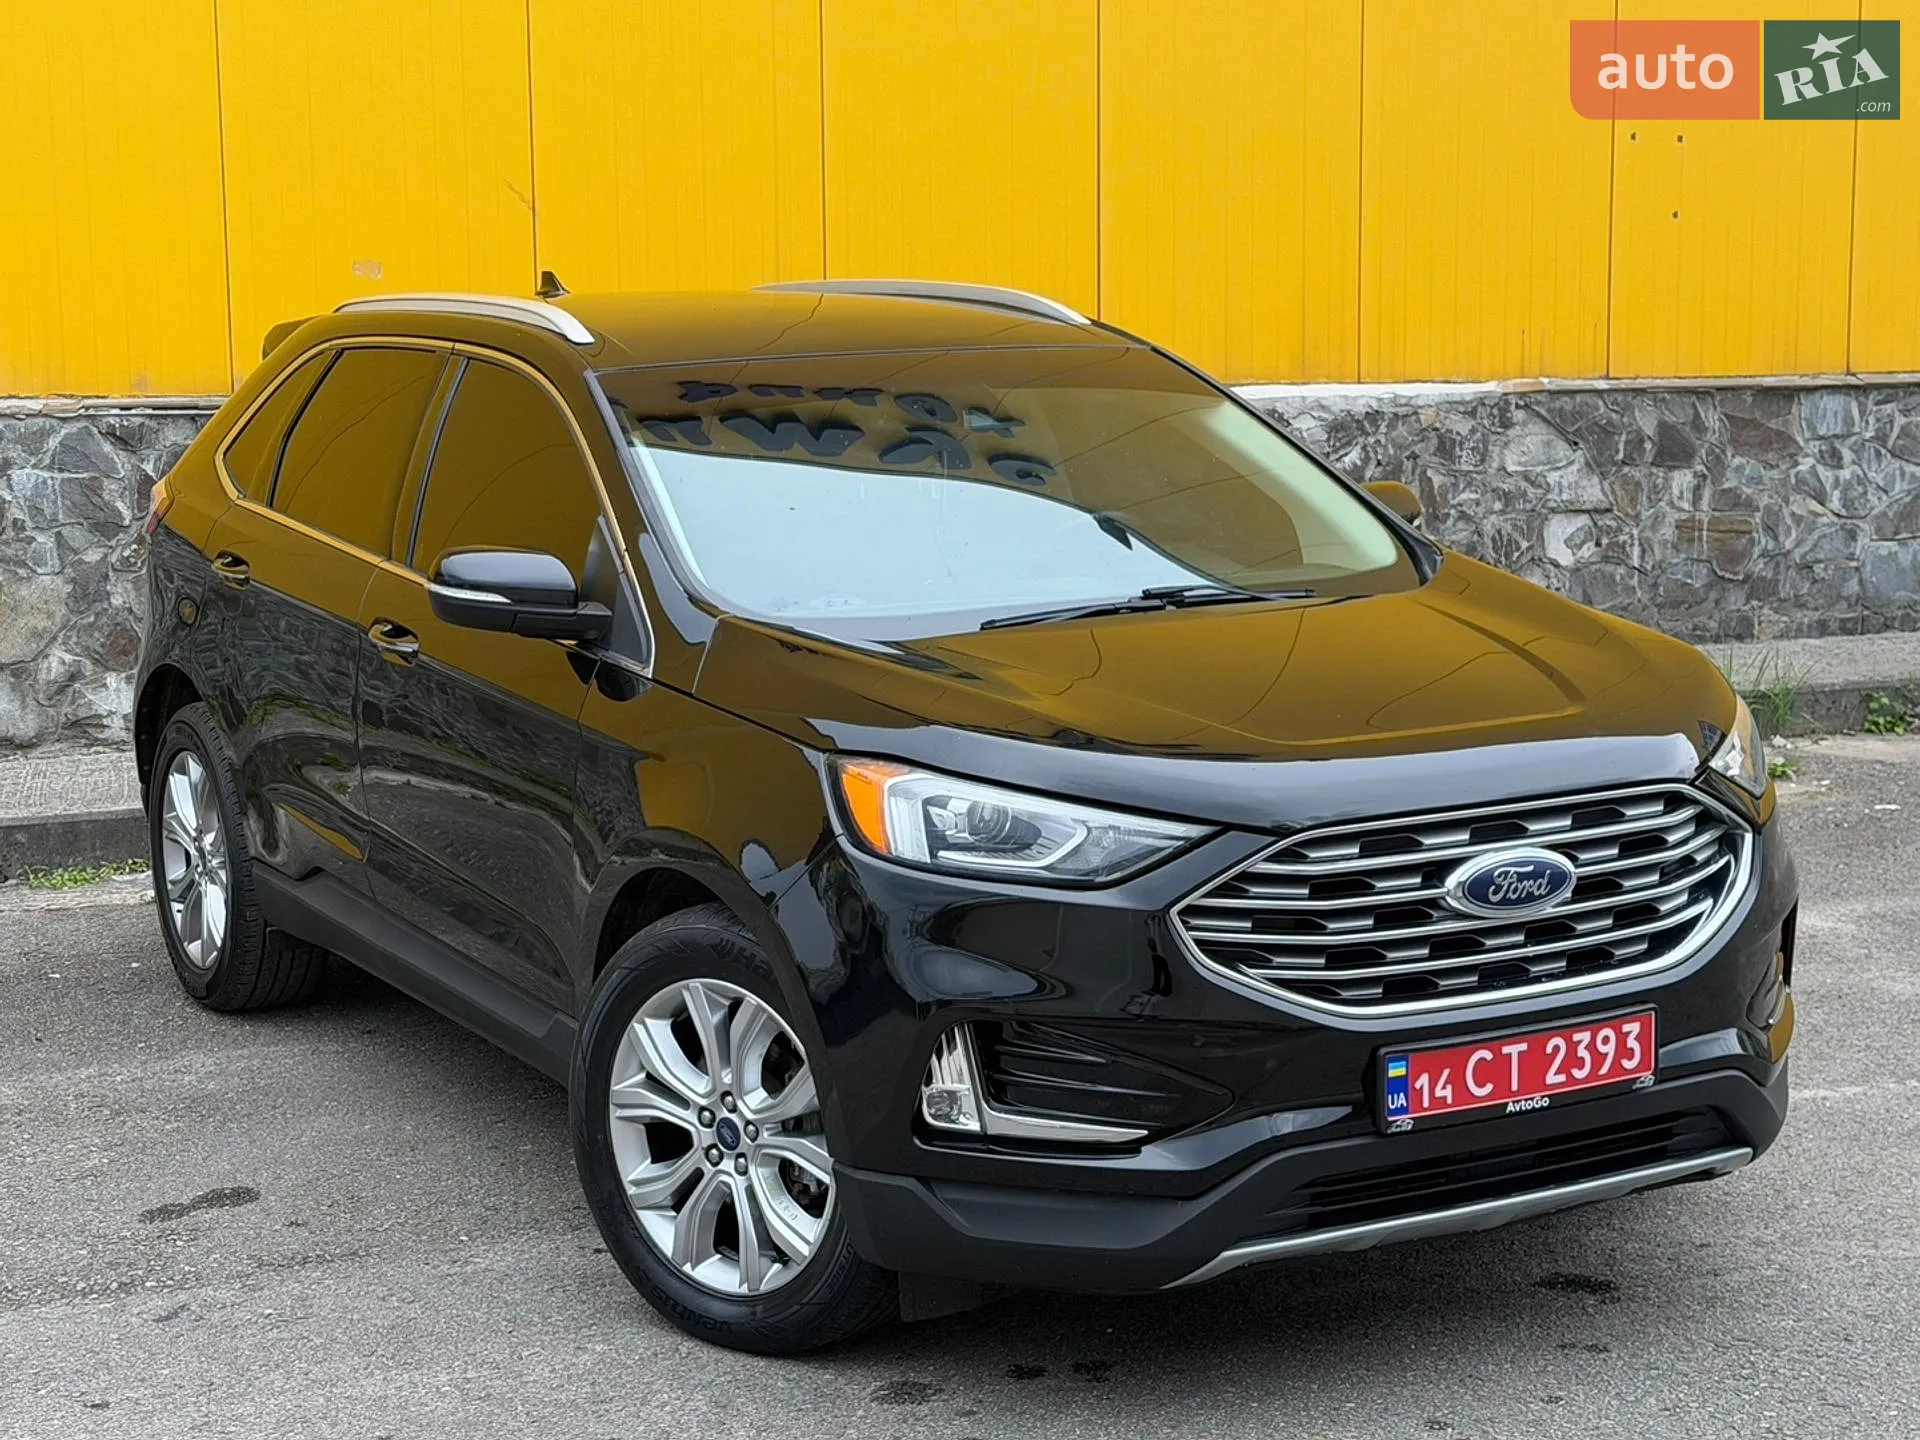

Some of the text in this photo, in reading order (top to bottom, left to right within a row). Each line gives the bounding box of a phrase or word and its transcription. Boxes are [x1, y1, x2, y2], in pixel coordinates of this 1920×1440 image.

[1488, 864, 1550, 903] Ford
[1414, 1021, 1642, 1109] 14 CT 2393
[1387, 1092, 1407, 1110] UA
[1505, 1095, 1550, 1114] AvtoGo
